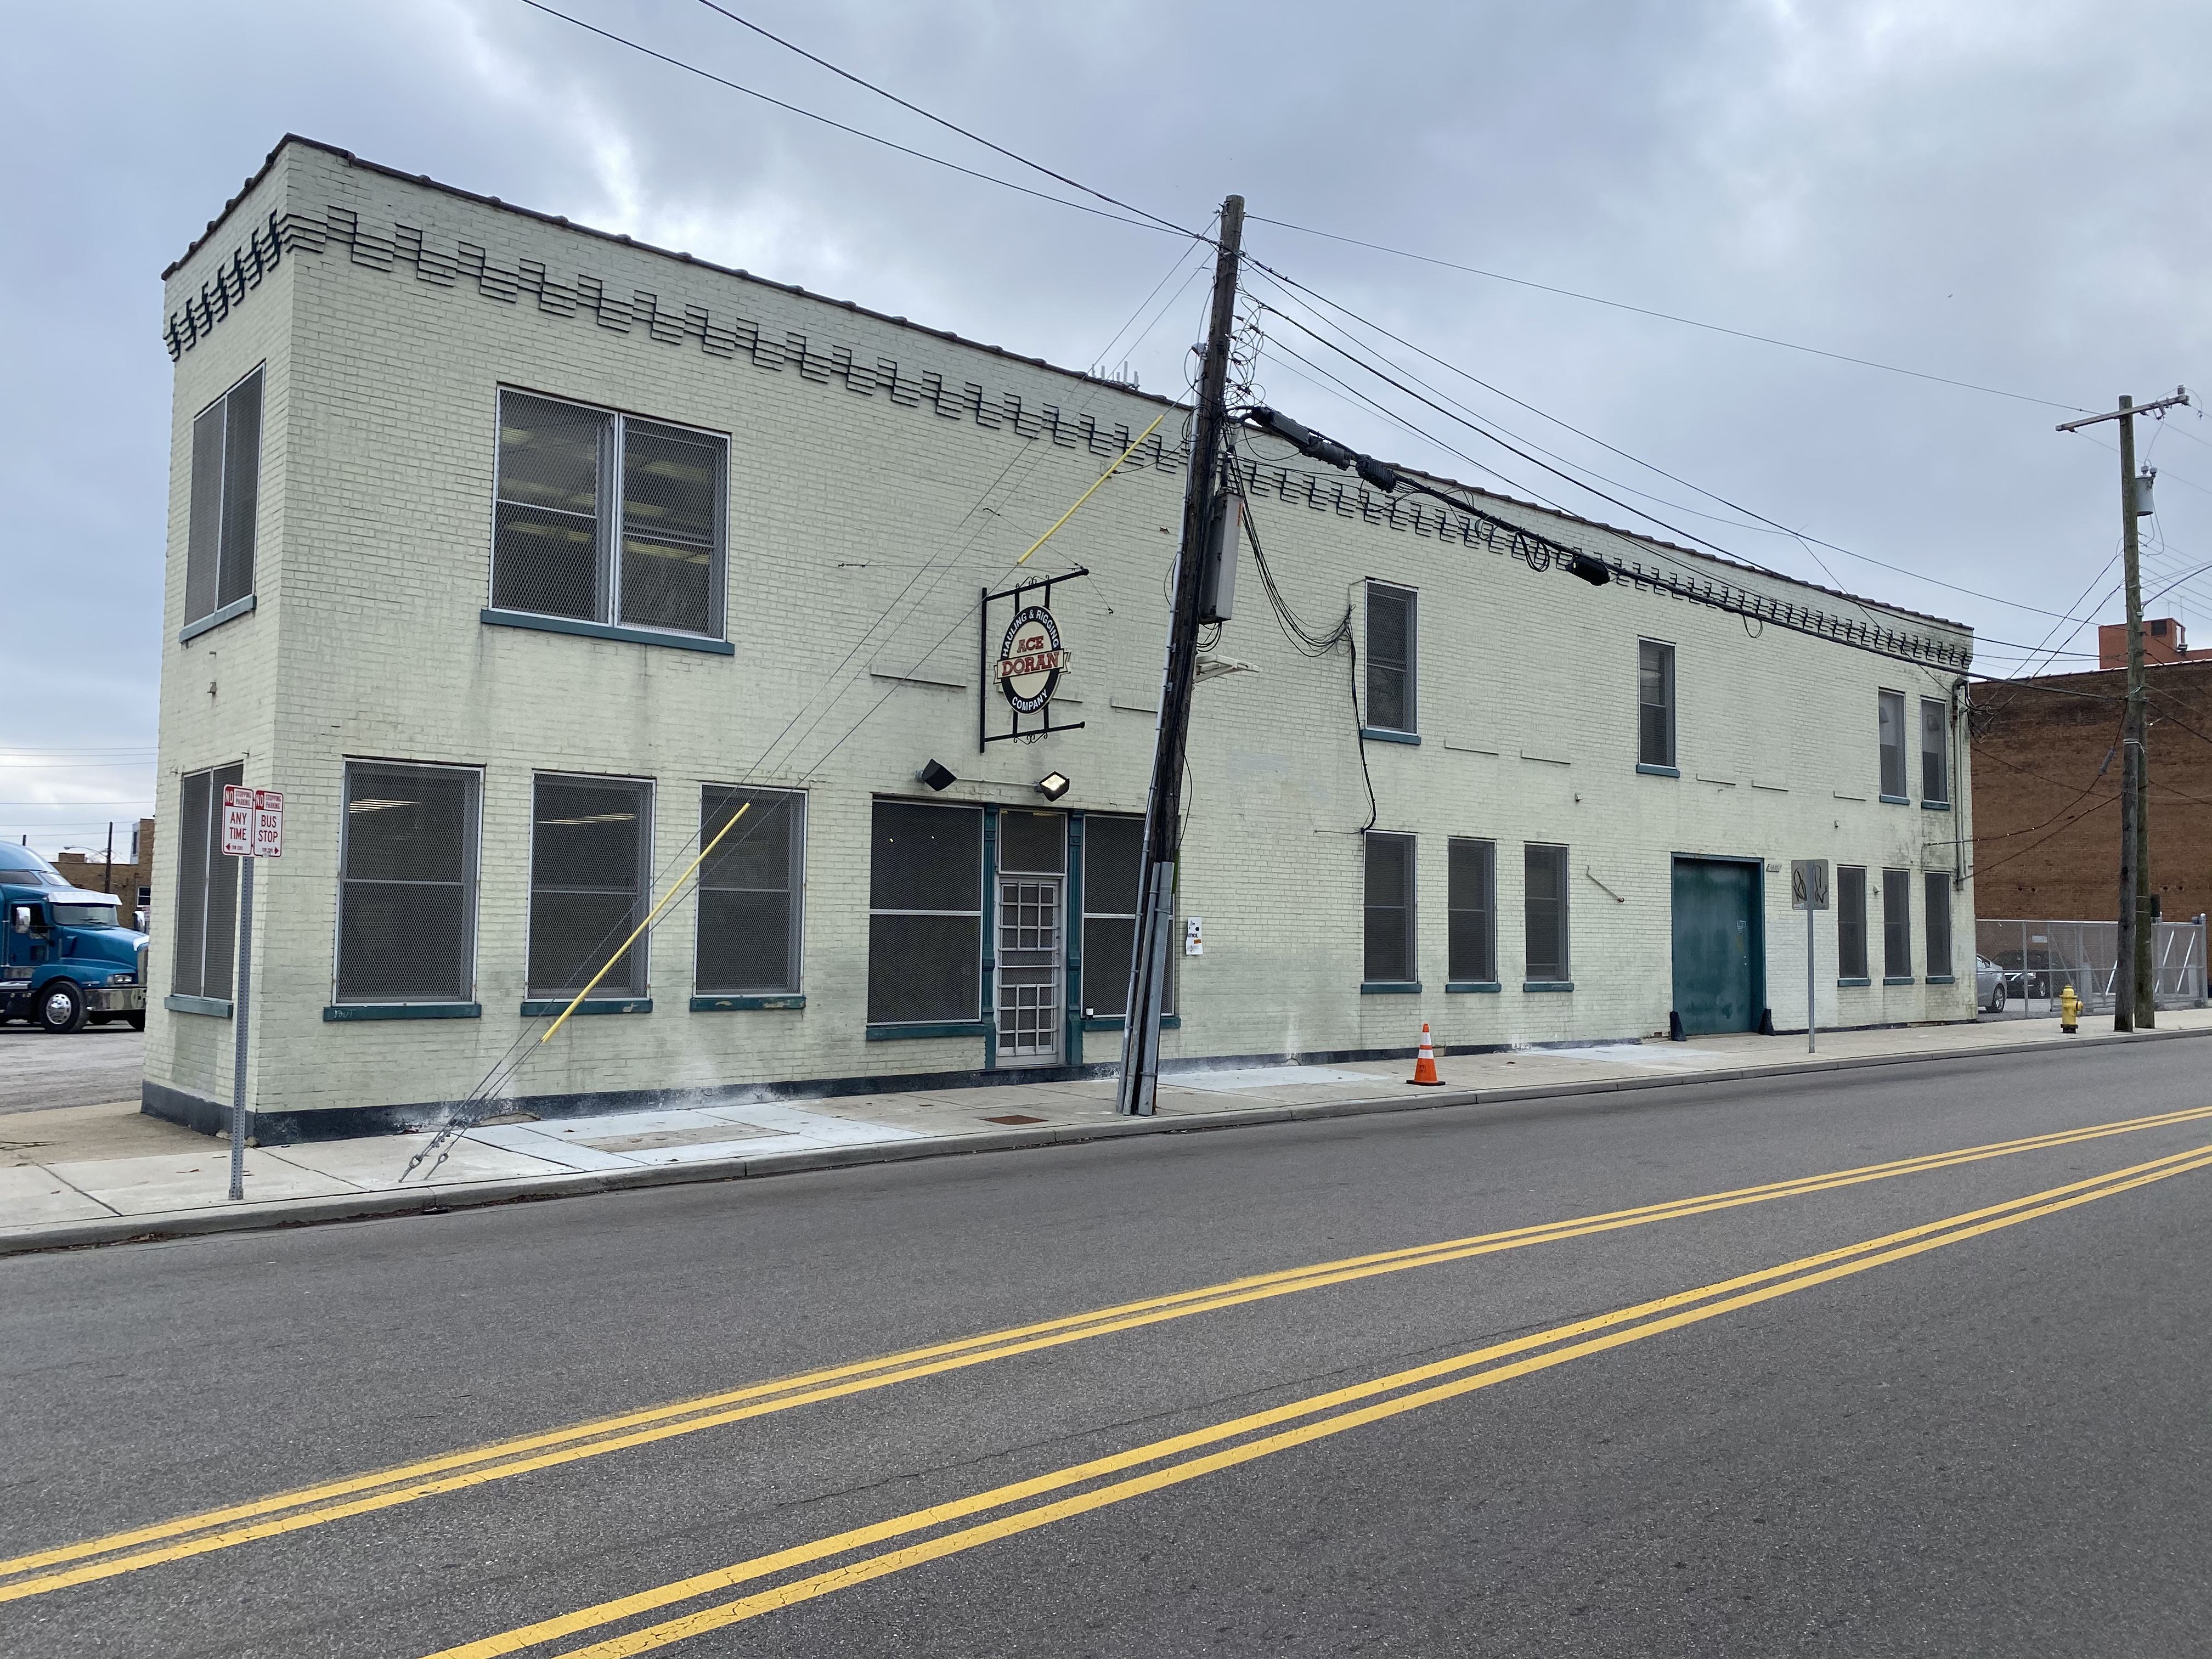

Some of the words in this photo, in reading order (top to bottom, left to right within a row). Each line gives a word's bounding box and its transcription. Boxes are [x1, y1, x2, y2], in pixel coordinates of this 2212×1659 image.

[1002, 612, 1027, 657] HAULING
[1029, 610, 1034, 619] &
[1036, 610, 1059, 648] RIGGING
[1017, 635, 1044, 653] ACE
[1002, 651, 1059, 676] DORAN
[1012, 689, 1048, 711] COMPANY
[225, 791, 233, 803] NO
[256, 794, 263, 806] NO
[230, 811, 247, 825] ANY
[261, 815, 277, 828] BUS
[229, 827, 247, 840] TIME
[258, 830, 278, 843] STOP
